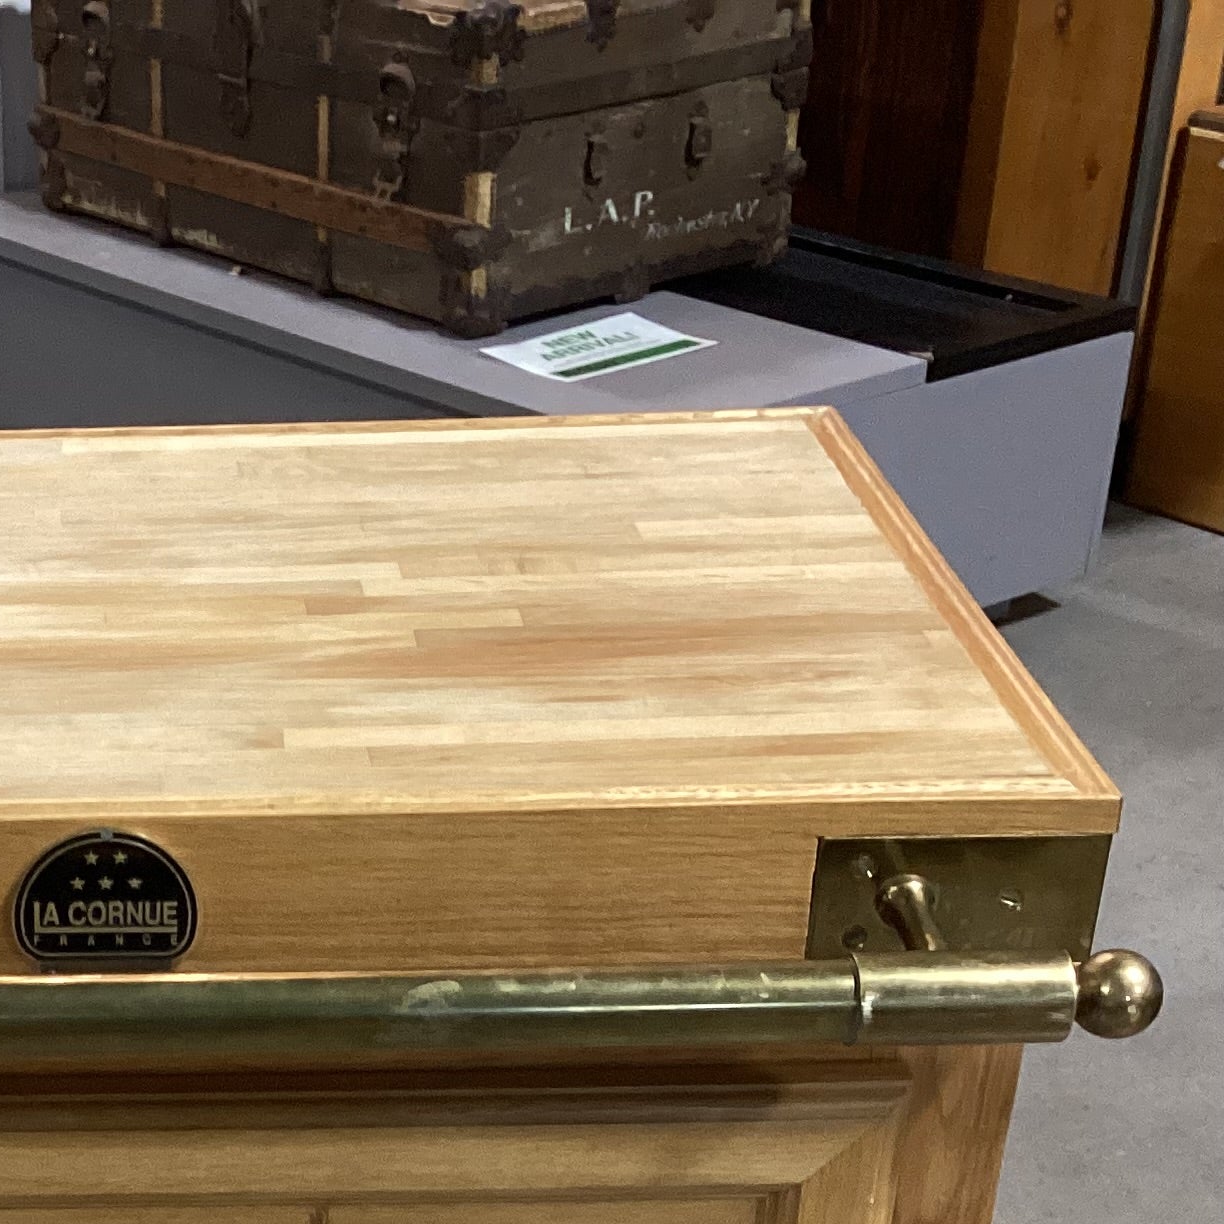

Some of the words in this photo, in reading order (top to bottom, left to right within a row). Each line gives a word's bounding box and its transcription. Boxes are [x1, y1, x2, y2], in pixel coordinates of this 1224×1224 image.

[540, 332, 640, 361] ARRIVAL!
[541, 330, 597, 348] NEW
[33, 900, 60, 934] LA
[67, 900, 178, 926] CORNUE
